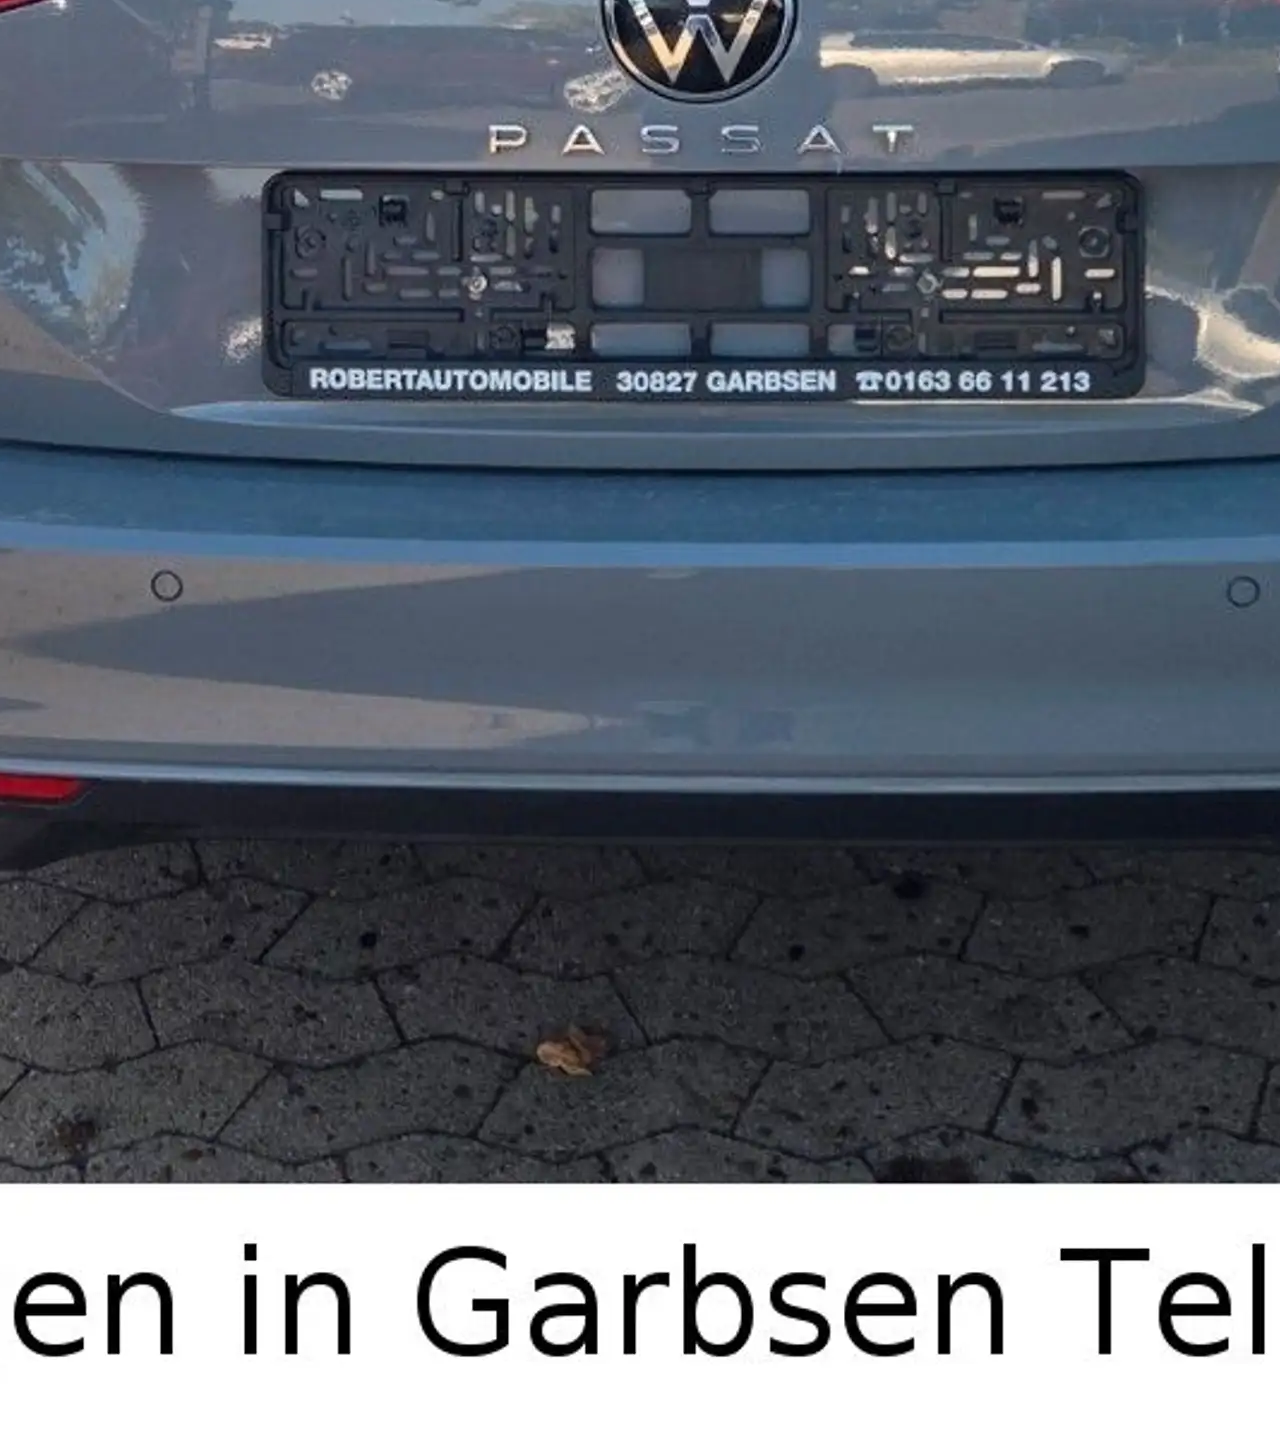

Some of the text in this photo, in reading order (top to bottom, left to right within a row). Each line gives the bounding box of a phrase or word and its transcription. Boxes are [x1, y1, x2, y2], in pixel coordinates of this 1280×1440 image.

[488, 124, 914, 157] PASSAT
[309, 368, 592, 392] ROBERTAUTOMOBILE
[616, 370, 697, 393] 30827
[706, 370, 837, 394] GARBSEN
[958, 370, 992, 394] 66
[1002, 370, 1030, 394] 11
[1040, 370, 1091, 394] 213
